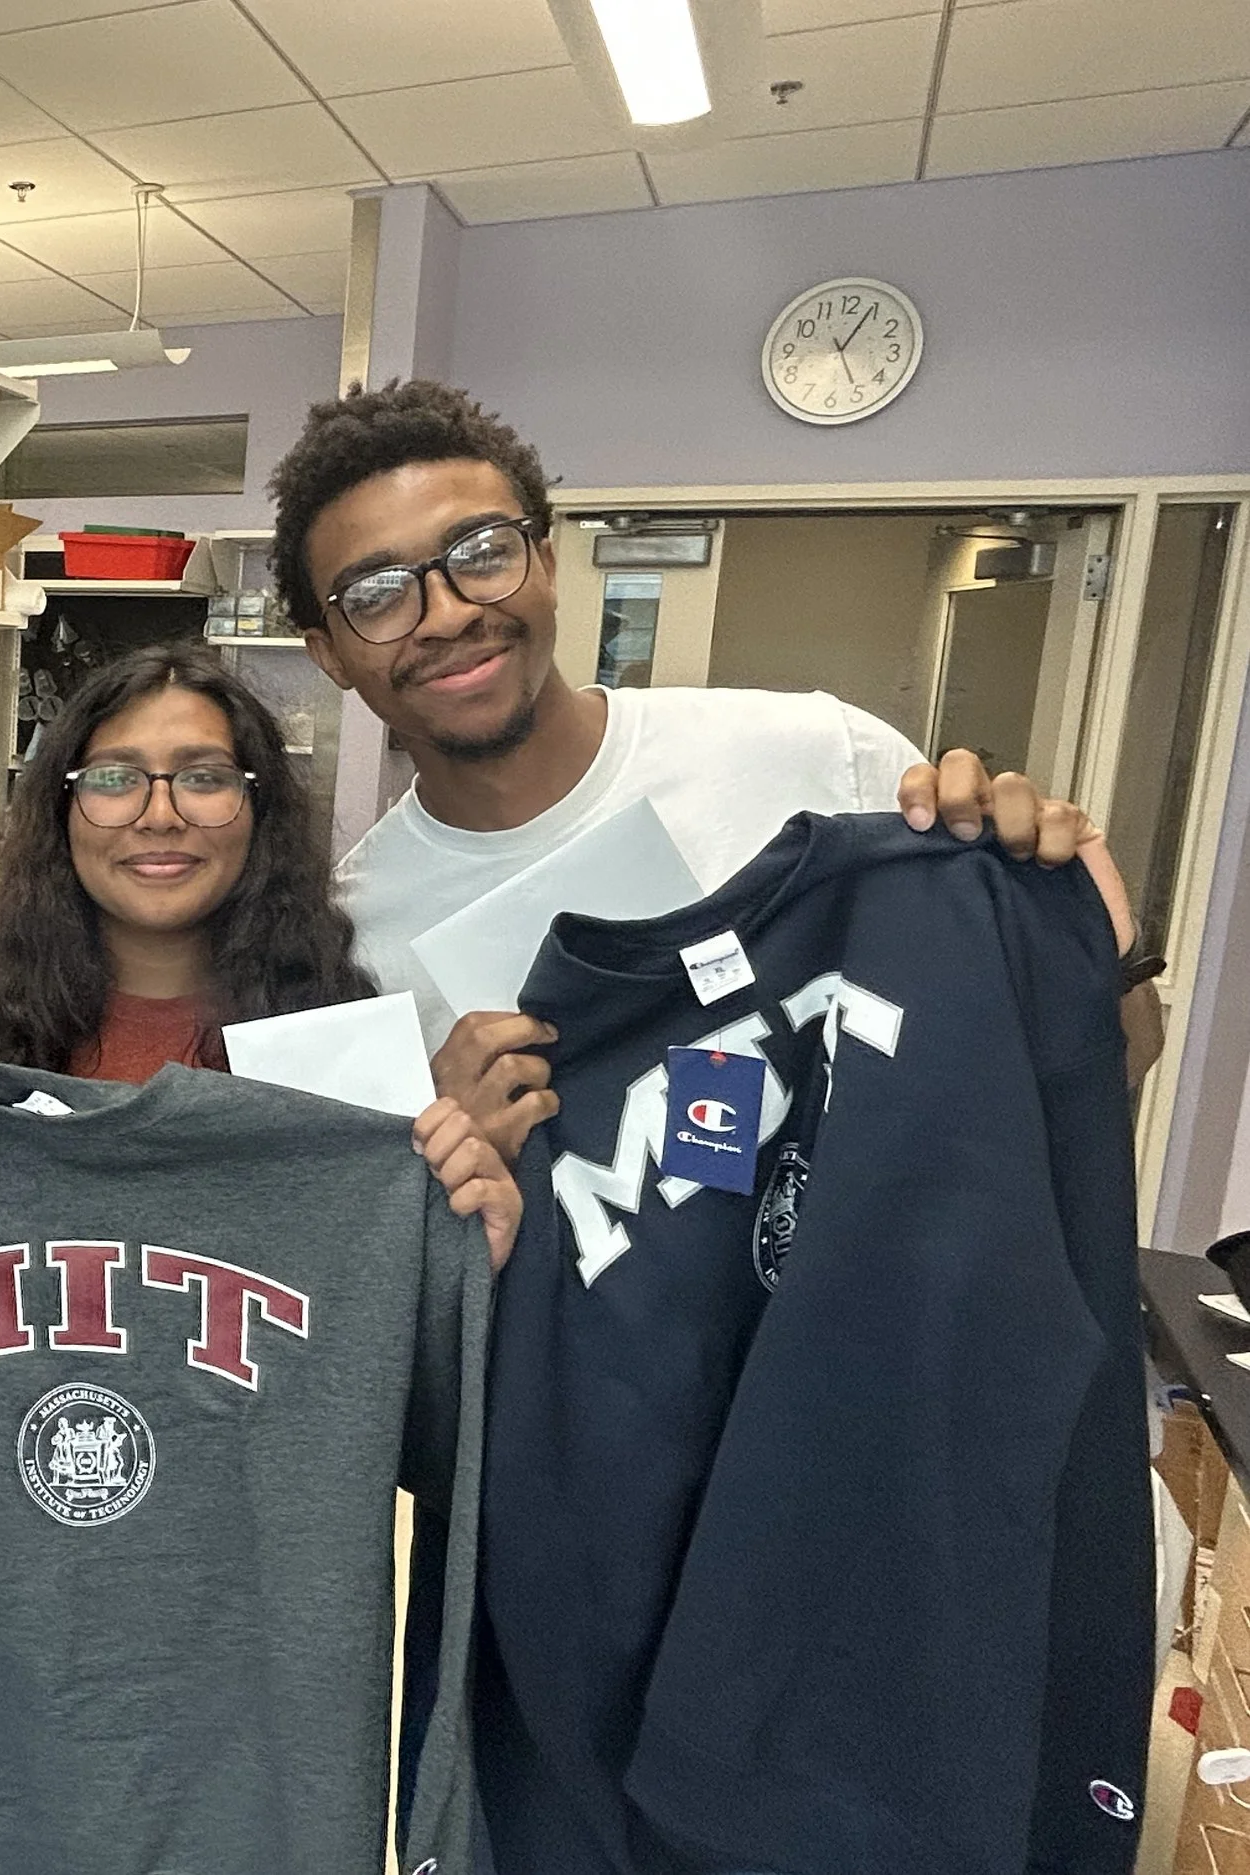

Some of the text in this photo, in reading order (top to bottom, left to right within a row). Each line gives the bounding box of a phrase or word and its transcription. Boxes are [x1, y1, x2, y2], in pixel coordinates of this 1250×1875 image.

[817, 302, 833, 320] 11
[841, 295, 861, 315] 12
[796, 319, 816, 338] 10
[883, 318, 899, 338] 2
[782, 343, 795, 360] 9
[886, 343, 900, 363] 3
[784, 365, 798, 384] 8
[872, 368, 886, 385] 4
[801, 383, 816, 401] 7
[824, 390, 838, 409] 6
[849, 384, 864, 404] 5
[677, 1130, 742, 1153] Champion
[39, 1389, 131, 1418] MASSACHUSETTS
[24, 1459, 71, 1517] INSTITUTE
[90, 1460, 149, 1519] TECHNOLOGY
